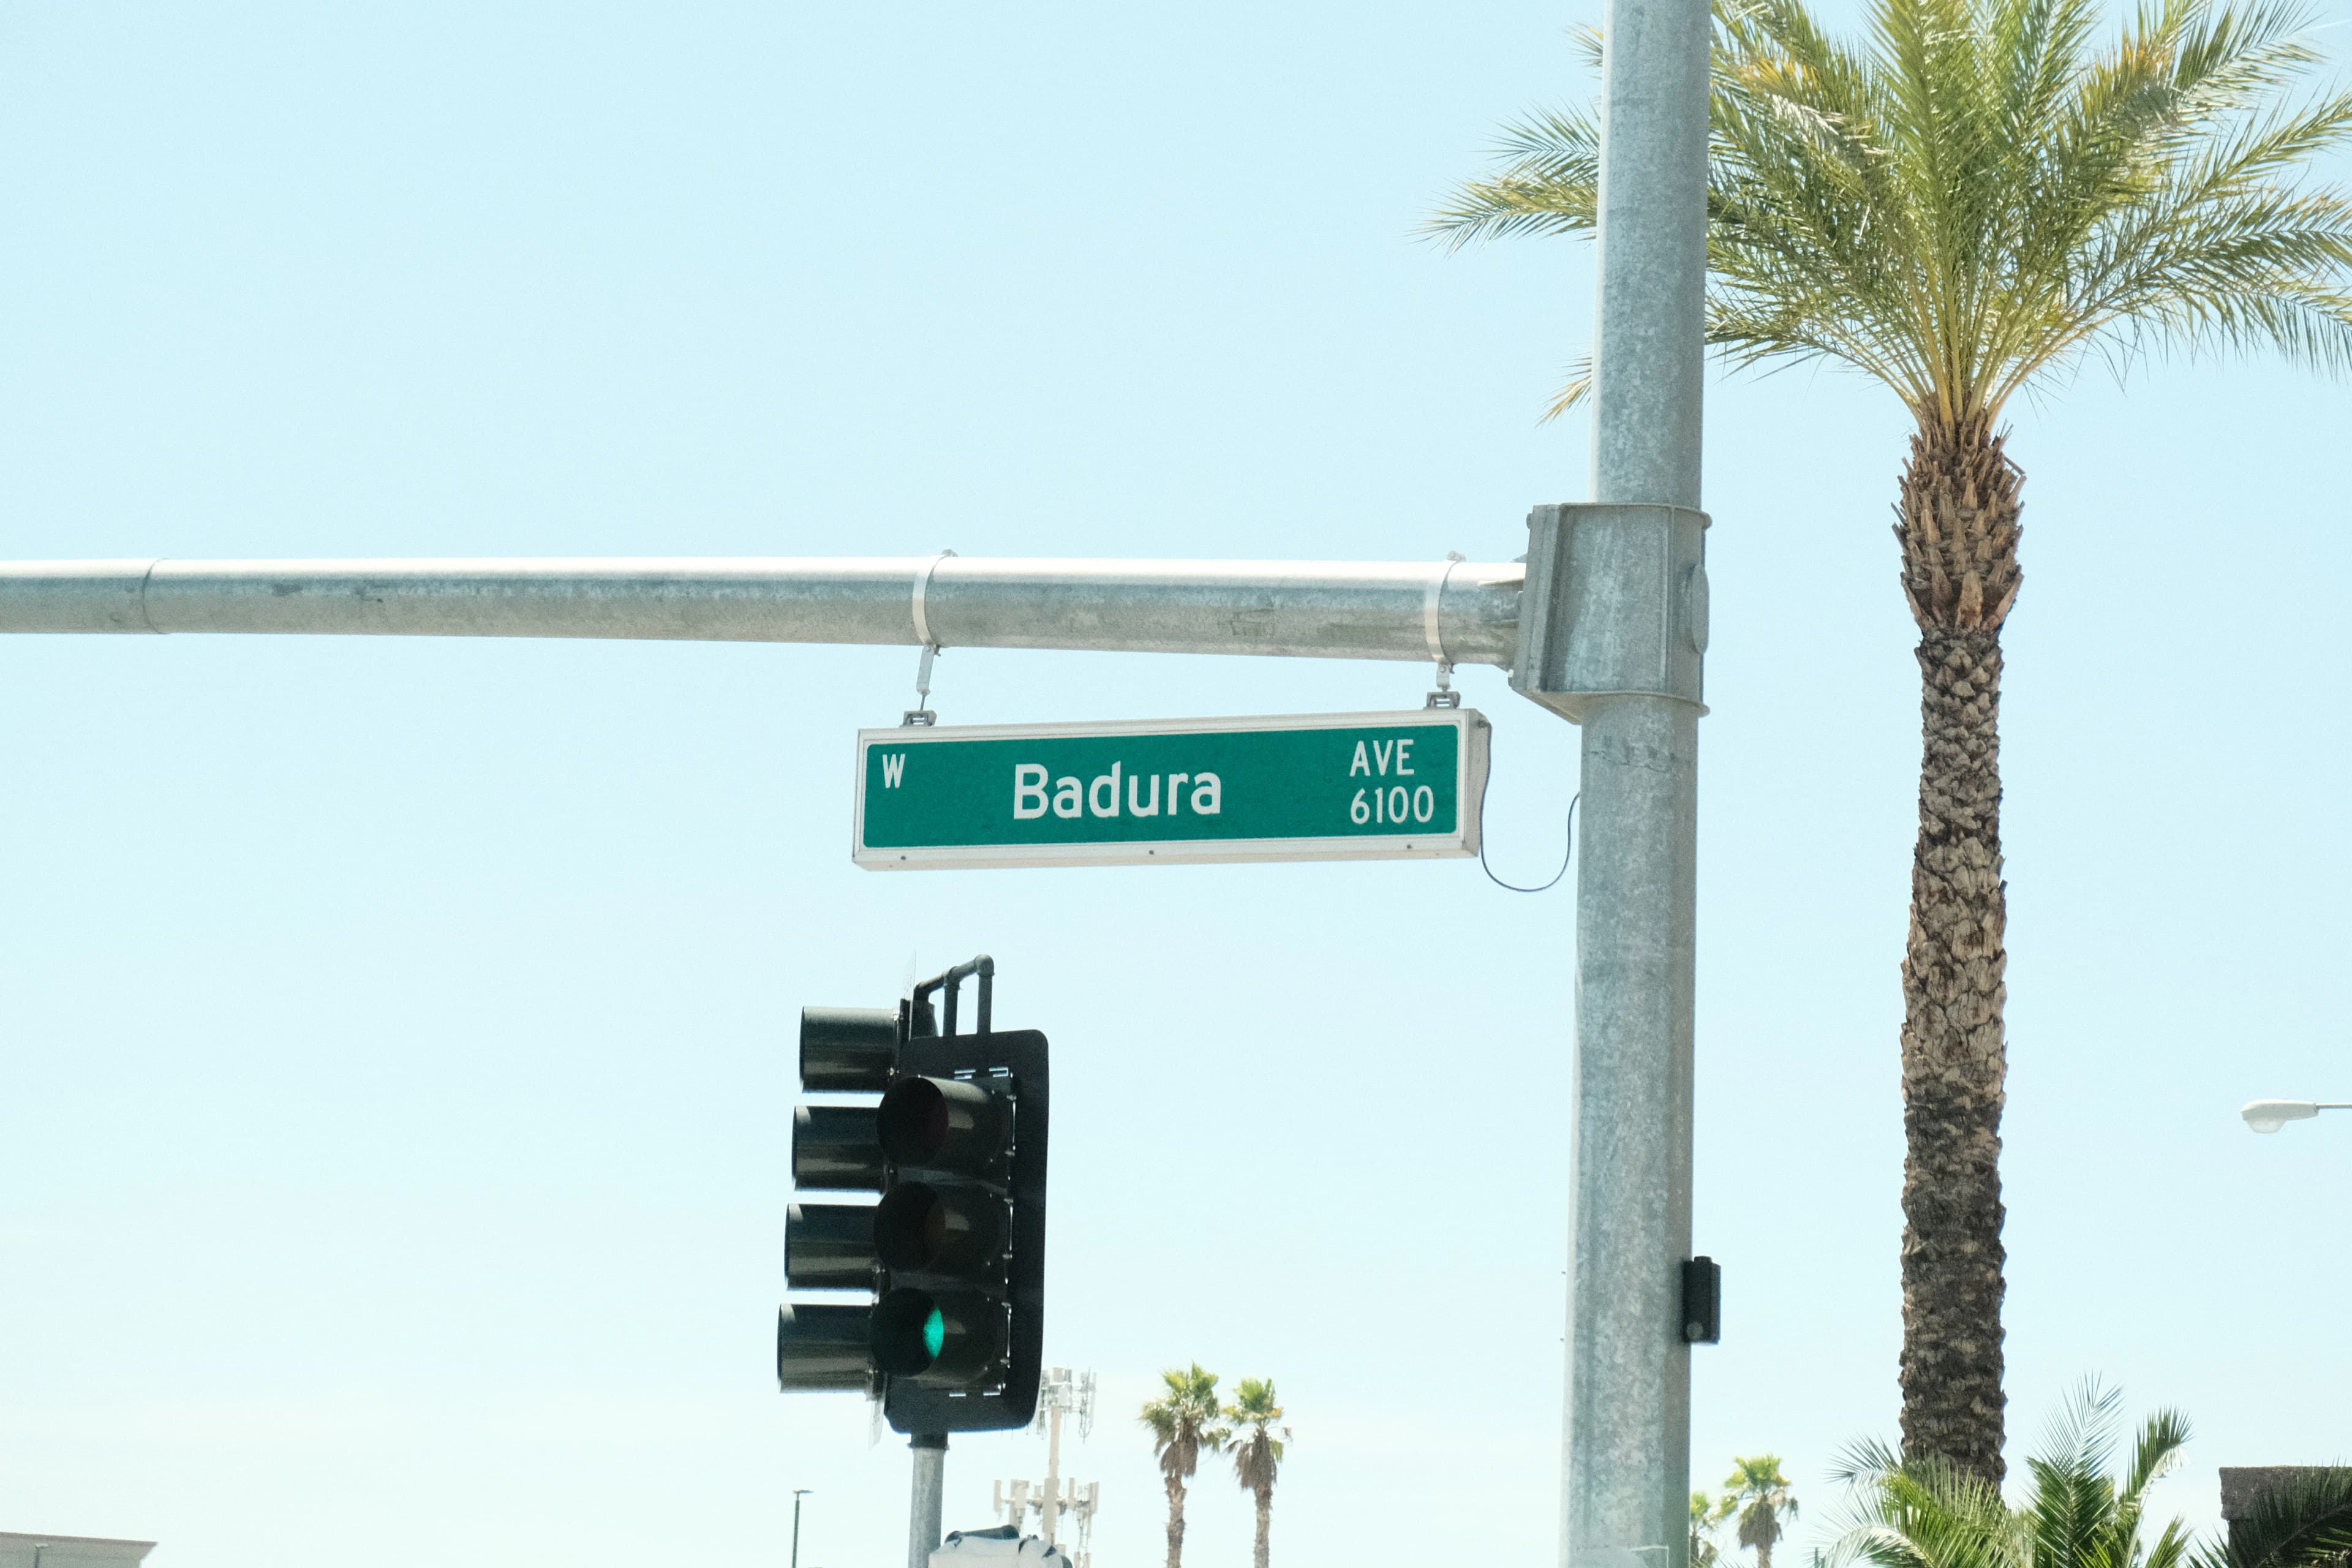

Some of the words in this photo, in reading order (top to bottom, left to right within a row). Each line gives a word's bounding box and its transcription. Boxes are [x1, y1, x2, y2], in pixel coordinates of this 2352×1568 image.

[882, 753, 905, 788] W
[1014, 761, 1221, 820] Badura
[1349, 739, 1415, 777] AVE
[1351, 785, 1434, 824] 6100
